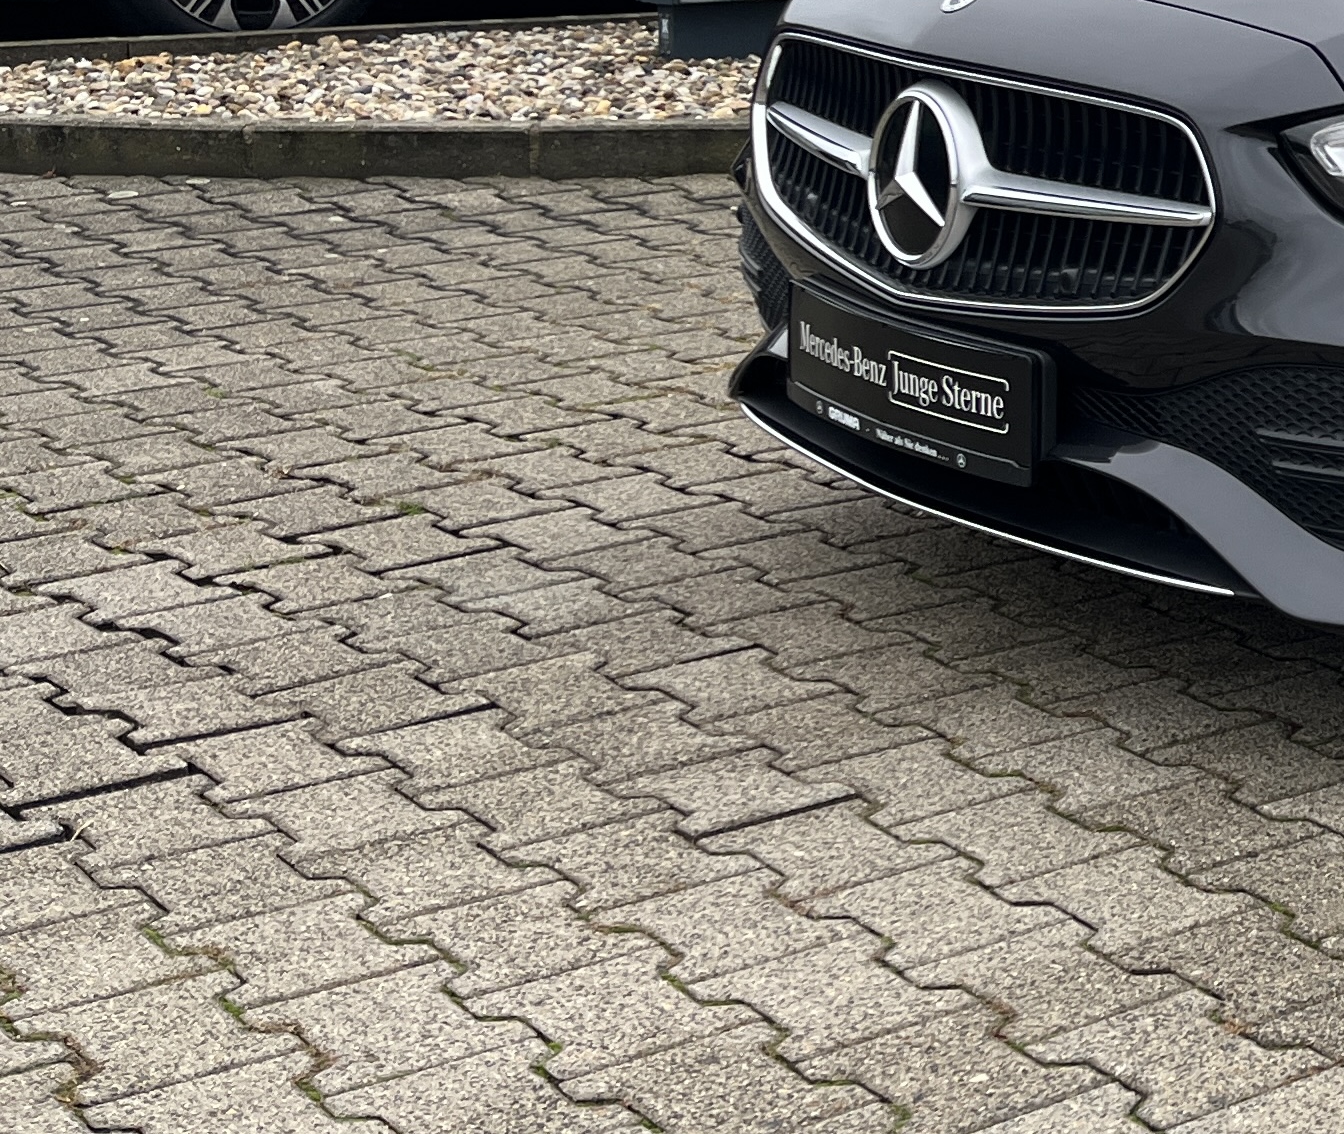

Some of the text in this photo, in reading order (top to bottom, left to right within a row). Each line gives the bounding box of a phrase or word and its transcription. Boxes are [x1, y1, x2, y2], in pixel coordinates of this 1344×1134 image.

[799, 321, 1004, 420] Mercedes-Benz Junge Sterne
